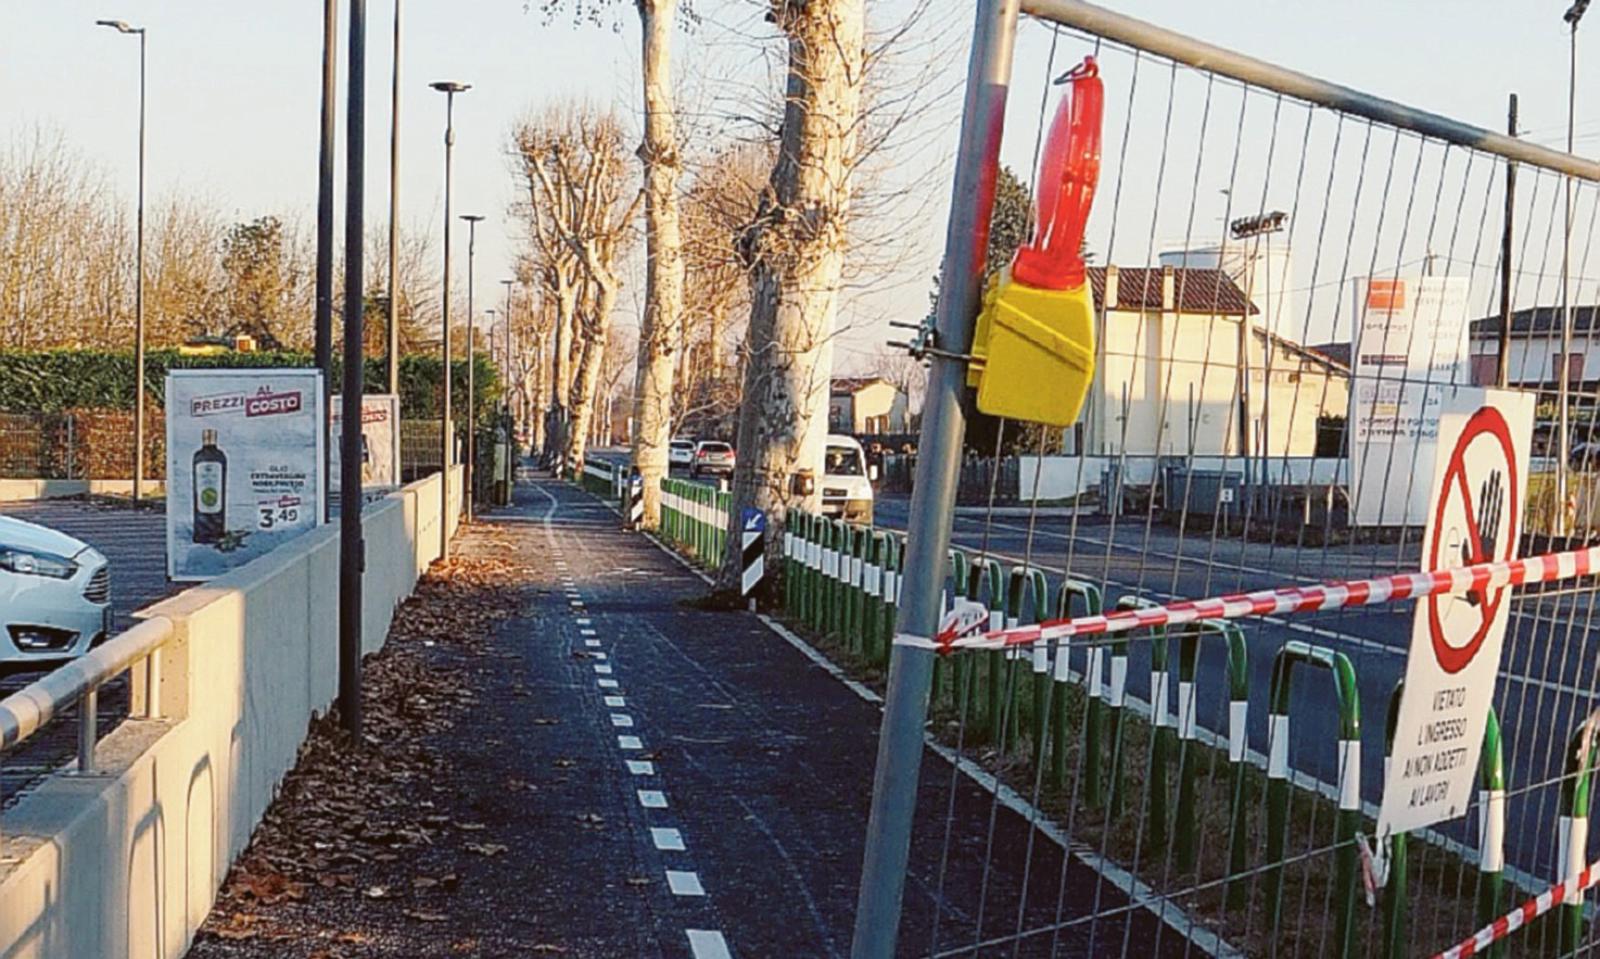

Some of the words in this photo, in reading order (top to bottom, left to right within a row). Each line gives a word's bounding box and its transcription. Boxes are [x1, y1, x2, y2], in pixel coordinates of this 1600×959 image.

[257, 385, 273, 396] AL
[193, 397, 244, 413] PREZZI
[250, 397, 298, 413] COSTO
[1432, 687, 1466, 711] VIETATO
[1403, 758, 1414, 778] AI
[1413, 754, 1434, 776] NON
[1433, 748, 1468, 771] ADDETTI
[1409, 788, 1420, 808] AI
[1419, 780, 1450, 807] LAVORI
